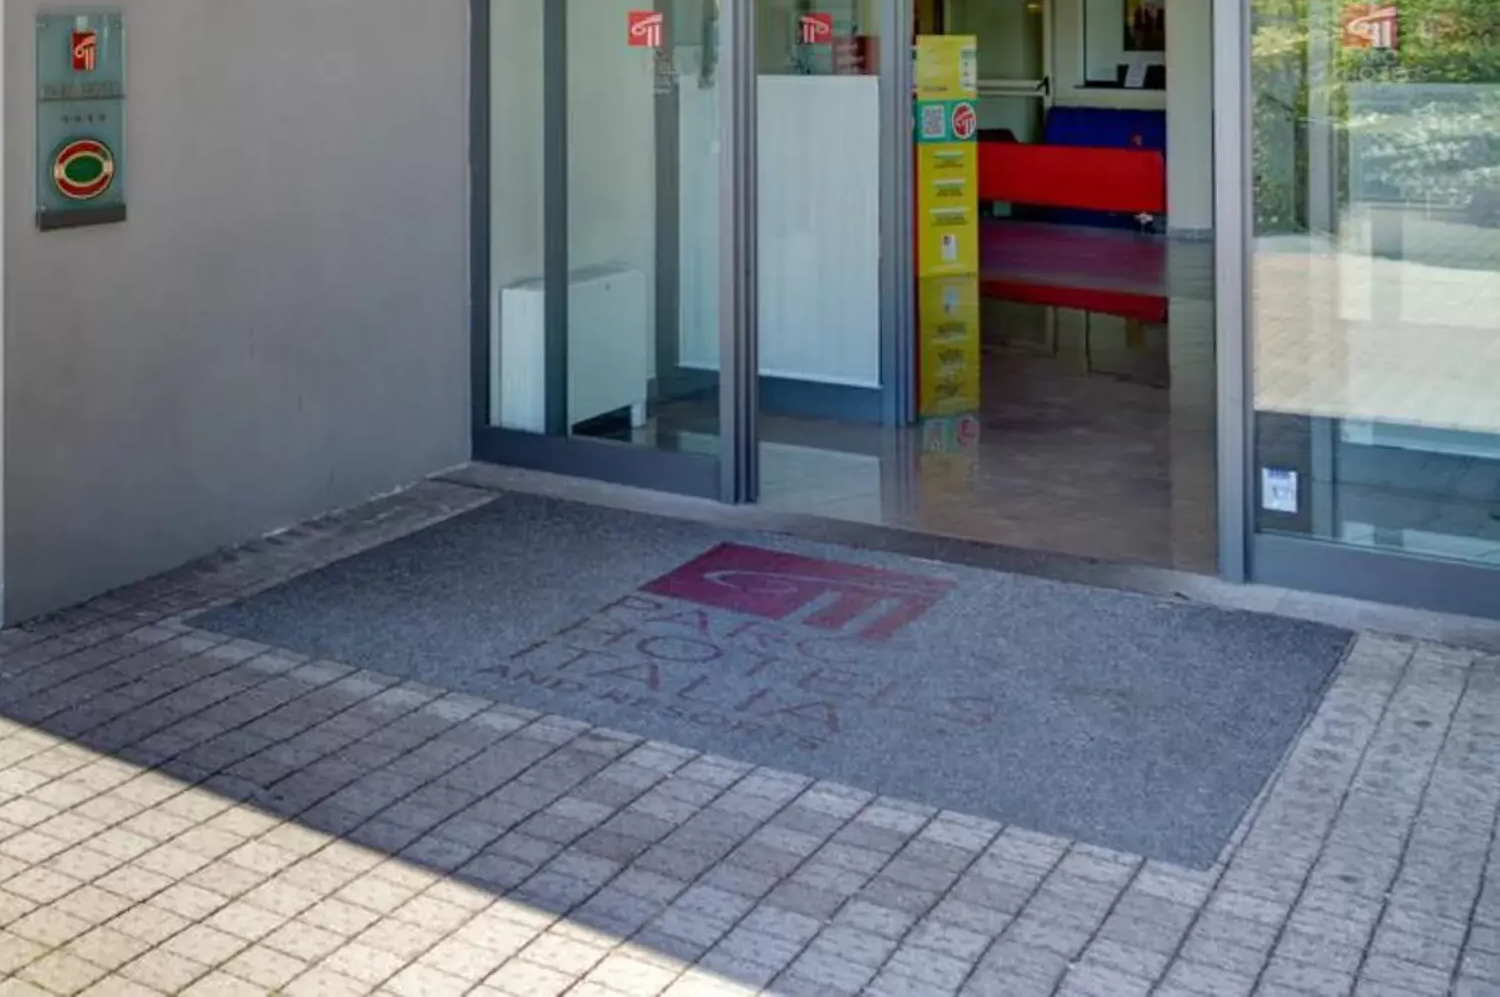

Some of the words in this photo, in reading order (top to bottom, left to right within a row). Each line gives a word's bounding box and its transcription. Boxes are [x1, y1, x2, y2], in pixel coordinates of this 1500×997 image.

[596, 594, 866, 664] PARC
[475, 663, 584, 693] AND
[509, 639, 840, 733] ITALIA
[553, 616, 1000, 727] HOTELS
